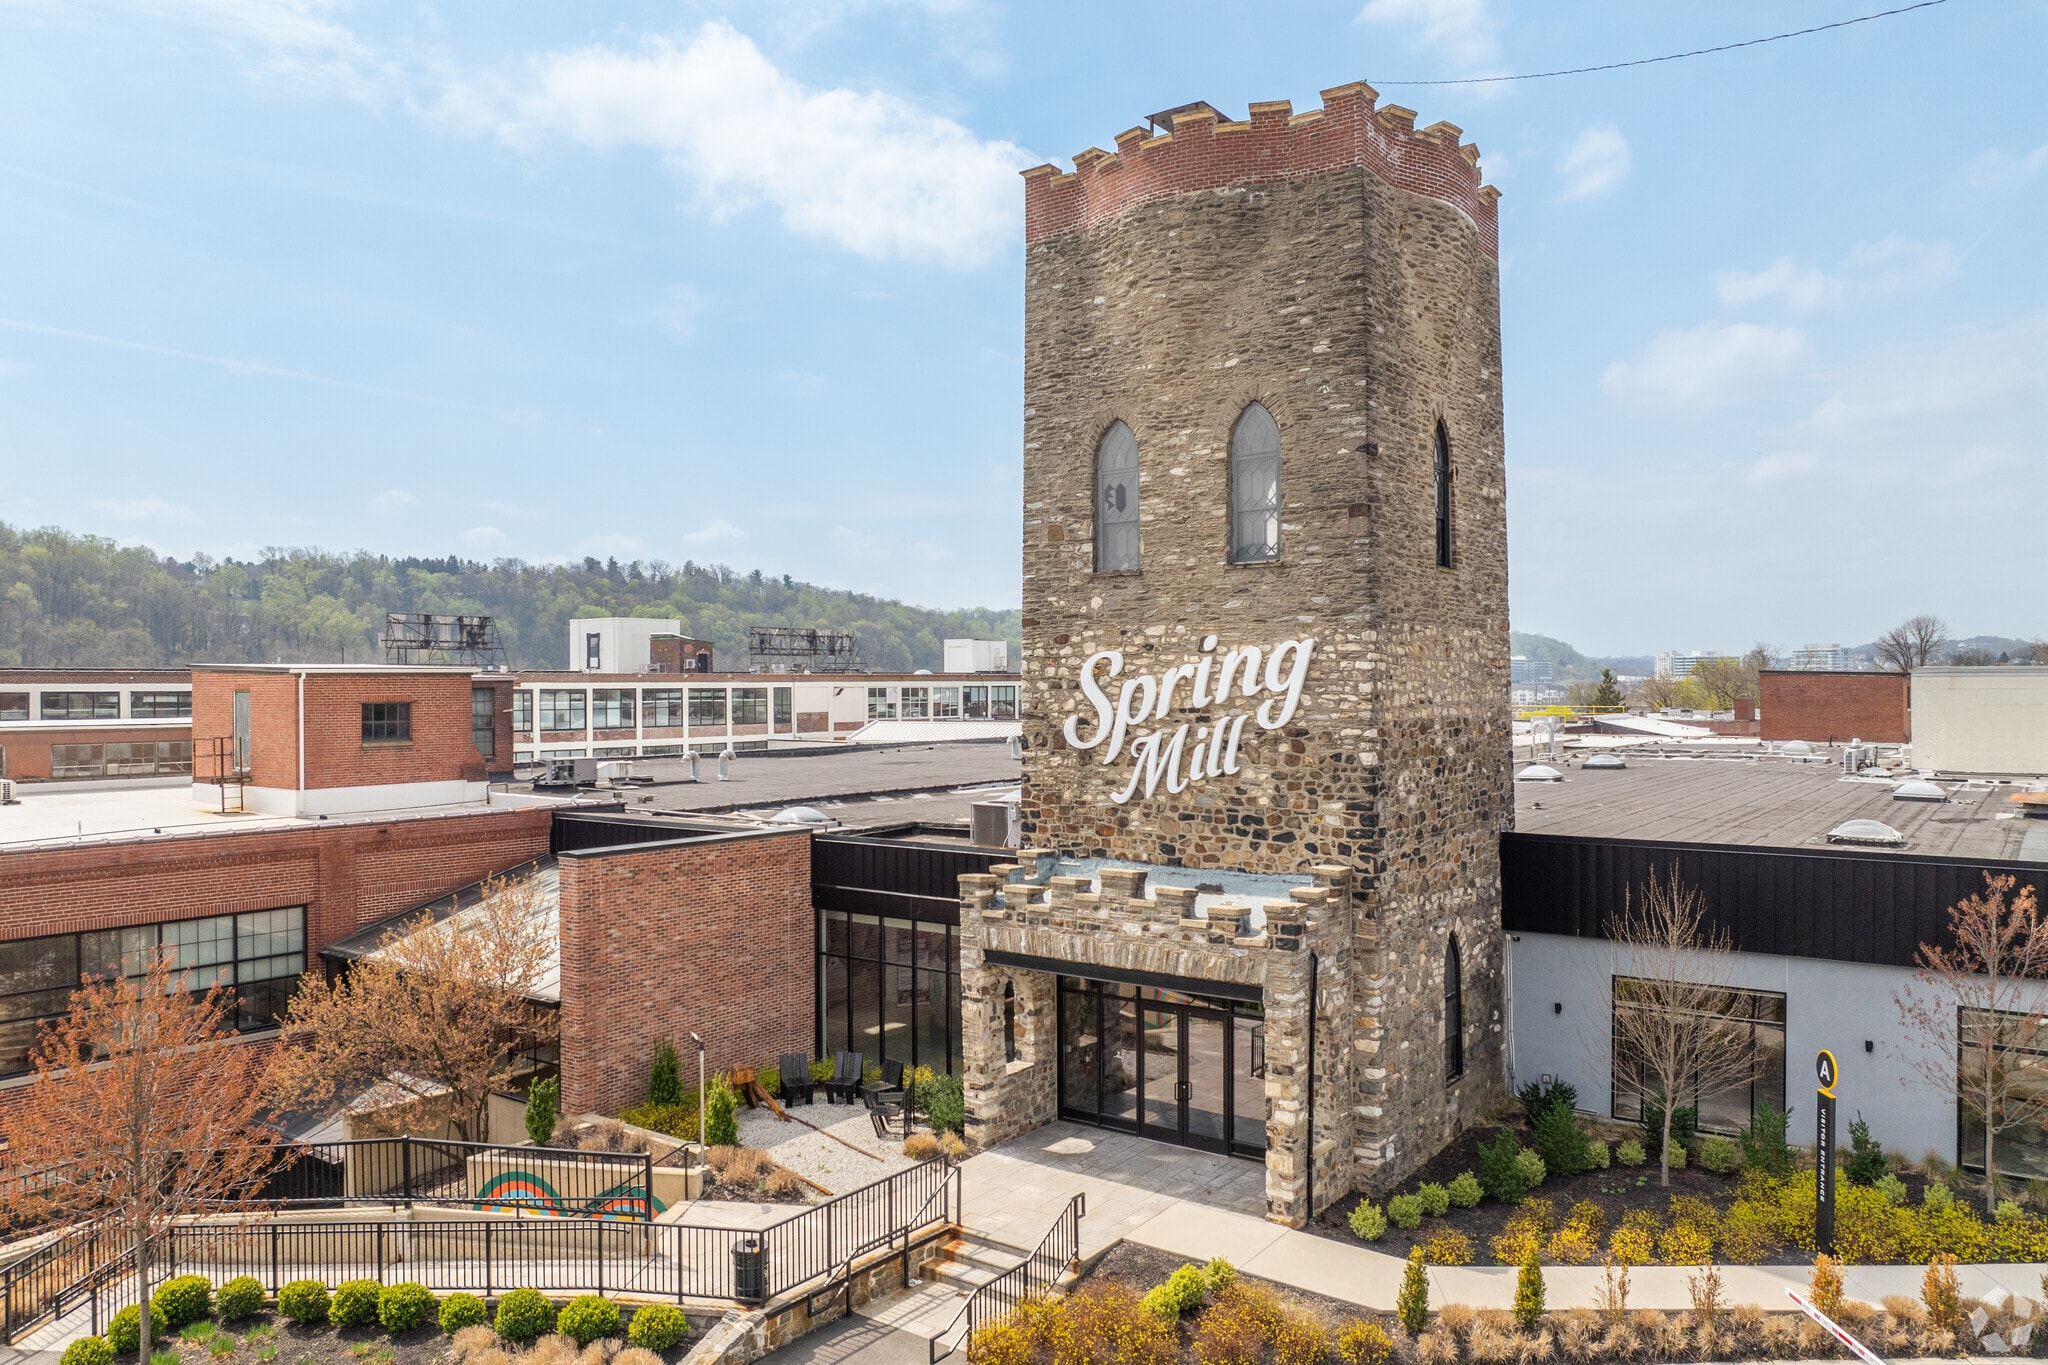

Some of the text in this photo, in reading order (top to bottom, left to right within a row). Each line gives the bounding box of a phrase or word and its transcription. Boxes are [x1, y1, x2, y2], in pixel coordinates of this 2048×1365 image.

[1063, 635, 1315, 765] Spring
[1110, 714, 1250, 804] Mill
[1820, 1060, 1831, 1082] A
